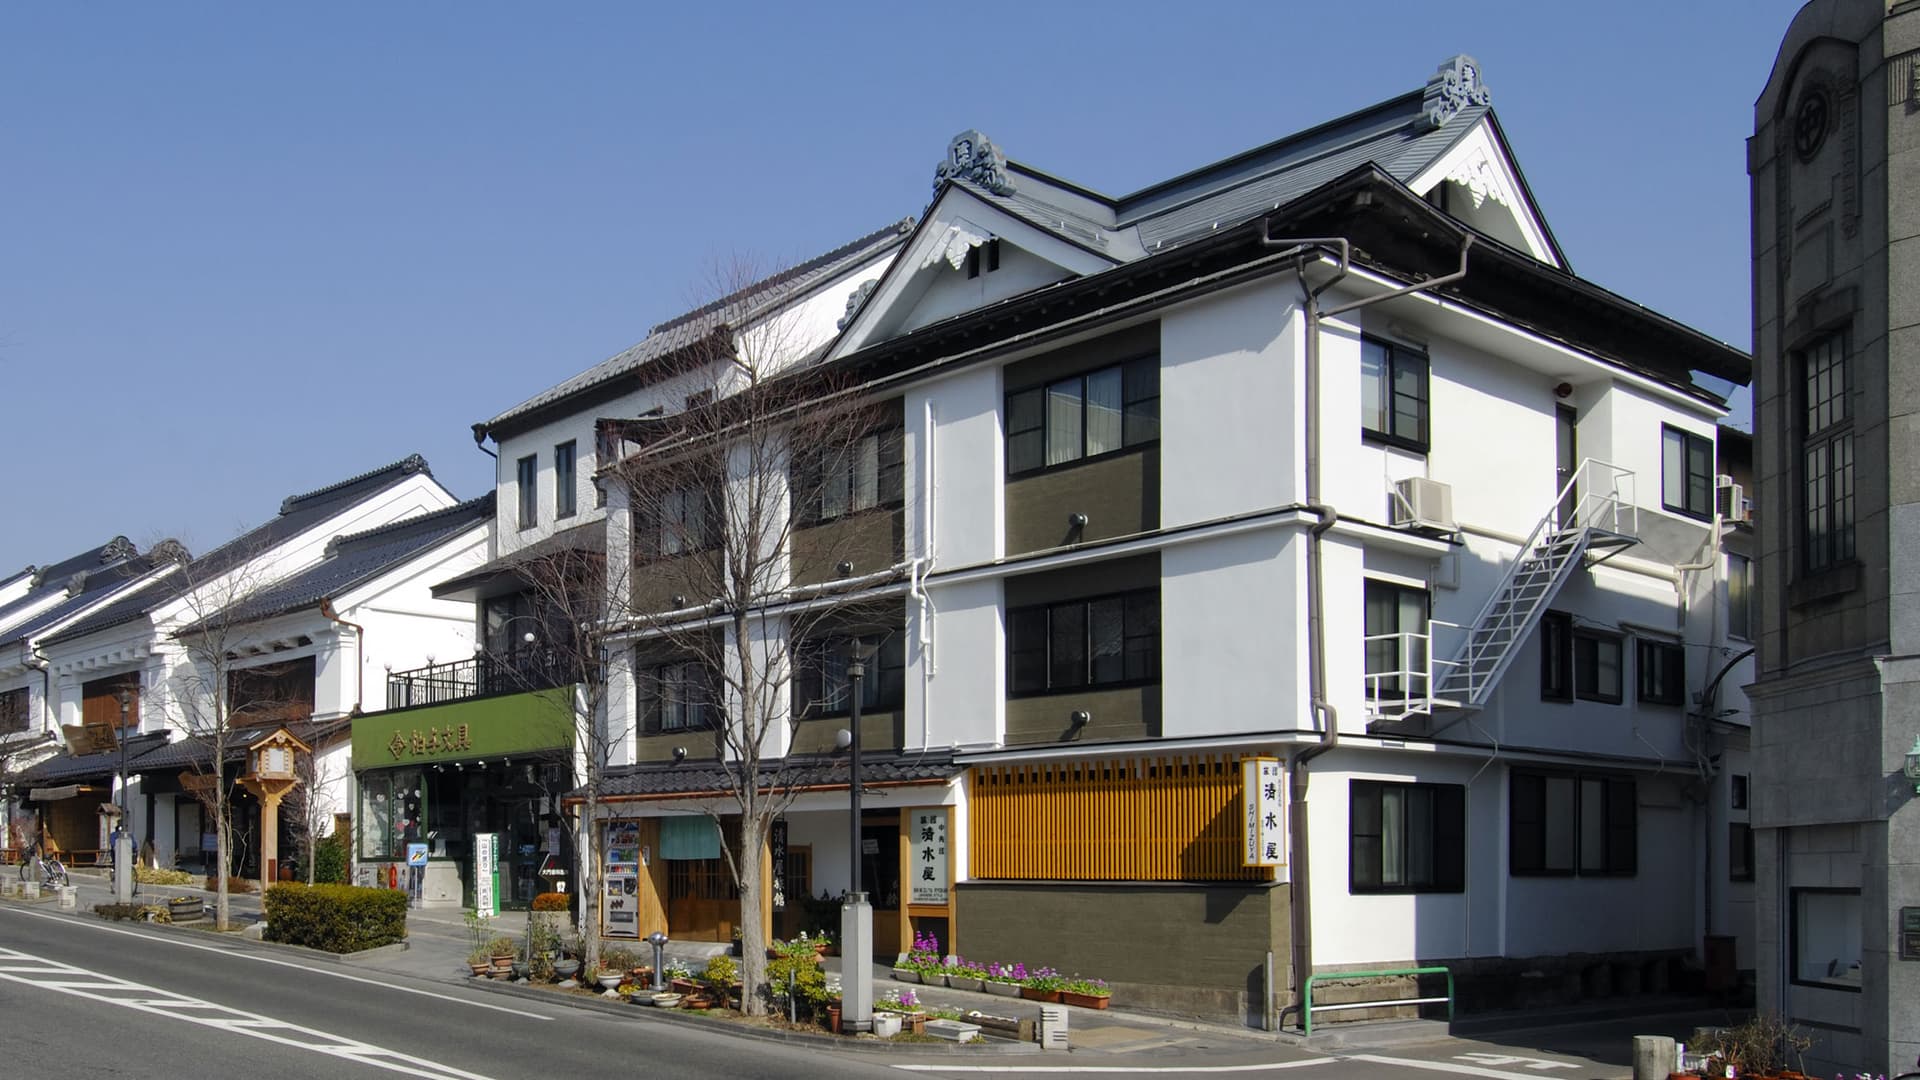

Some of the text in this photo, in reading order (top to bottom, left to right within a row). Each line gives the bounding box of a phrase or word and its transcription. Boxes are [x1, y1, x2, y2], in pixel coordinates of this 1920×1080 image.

[921, 826, 936, 882] 清水屋
[1264, 782, 1278, 860] 清水屋
